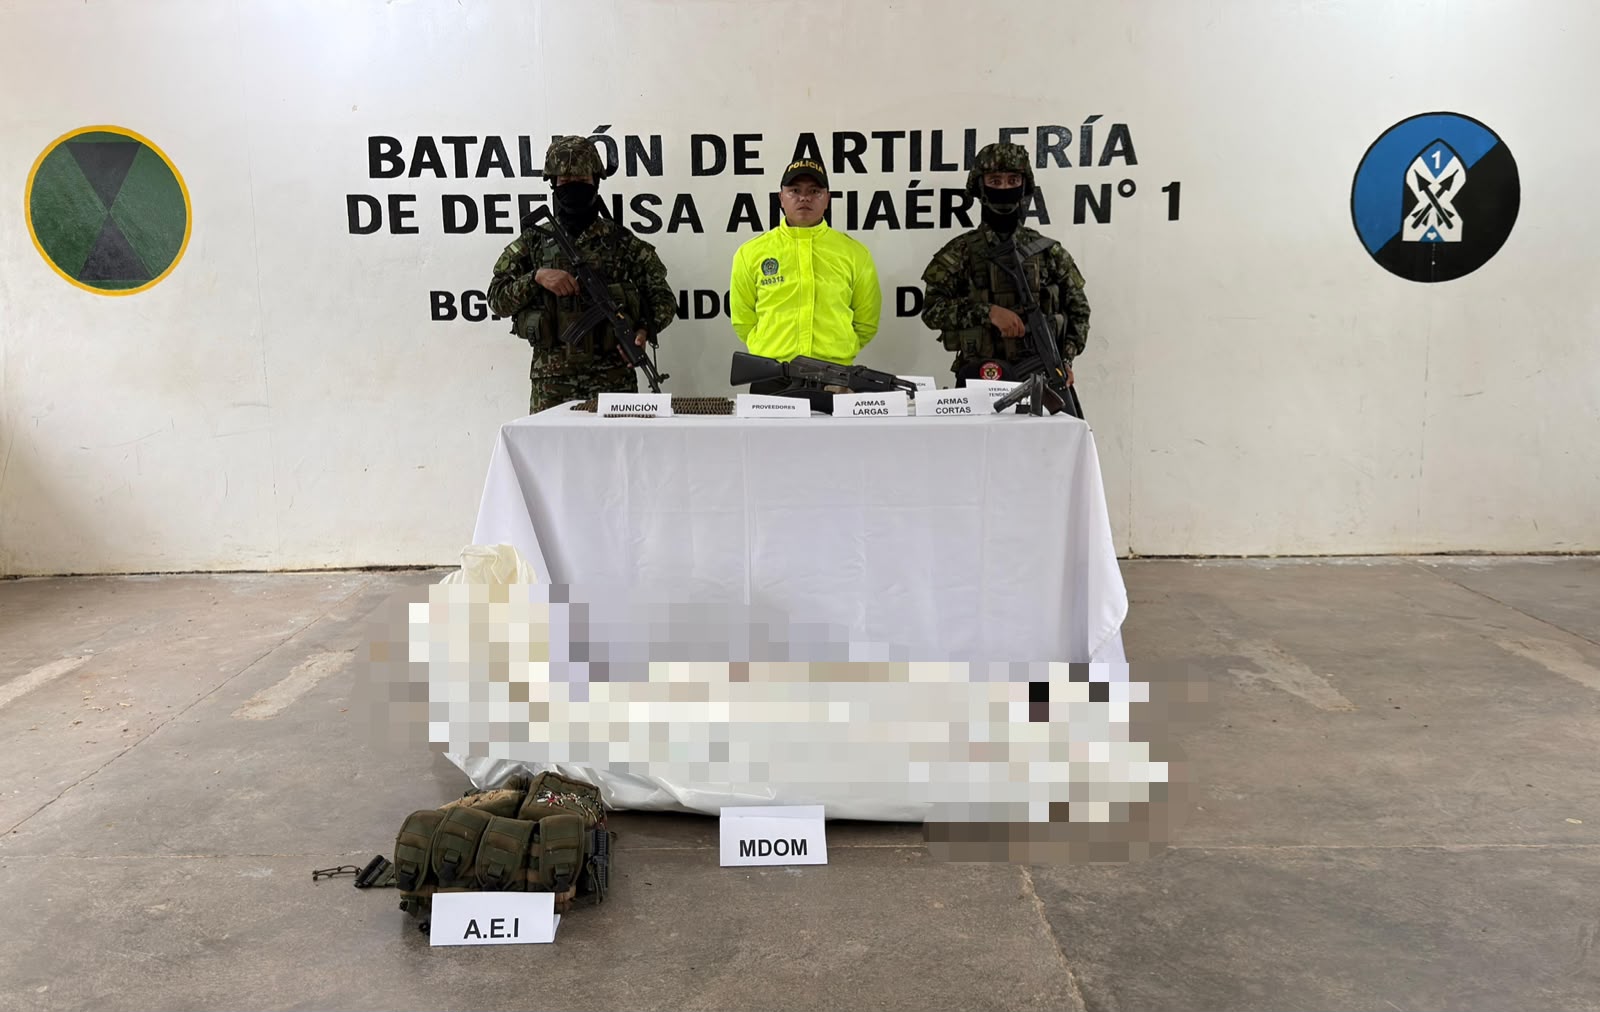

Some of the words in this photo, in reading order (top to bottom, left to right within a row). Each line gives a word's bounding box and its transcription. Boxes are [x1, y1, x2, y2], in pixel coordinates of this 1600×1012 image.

[367, 124, 664, 179] BATALÓN
[690, 133, 765, 177] DE
[1431, 150, 1441, 169] 1
[346, 193, 420, 235] DE
[441, 192, 704, 235] DEFNSA
[1161, 181, 1181, 221] 1
[610, 403, 658, 412] MUNICIÓN
[935, 406, 972, 415] CORTAS
[936, 397, 969, 405] ARMAS
[852, 408, 889, 416] LARGAS
[739, 838, 808, 858] MDOM
[463, 917, 519, 940] A.E.I
